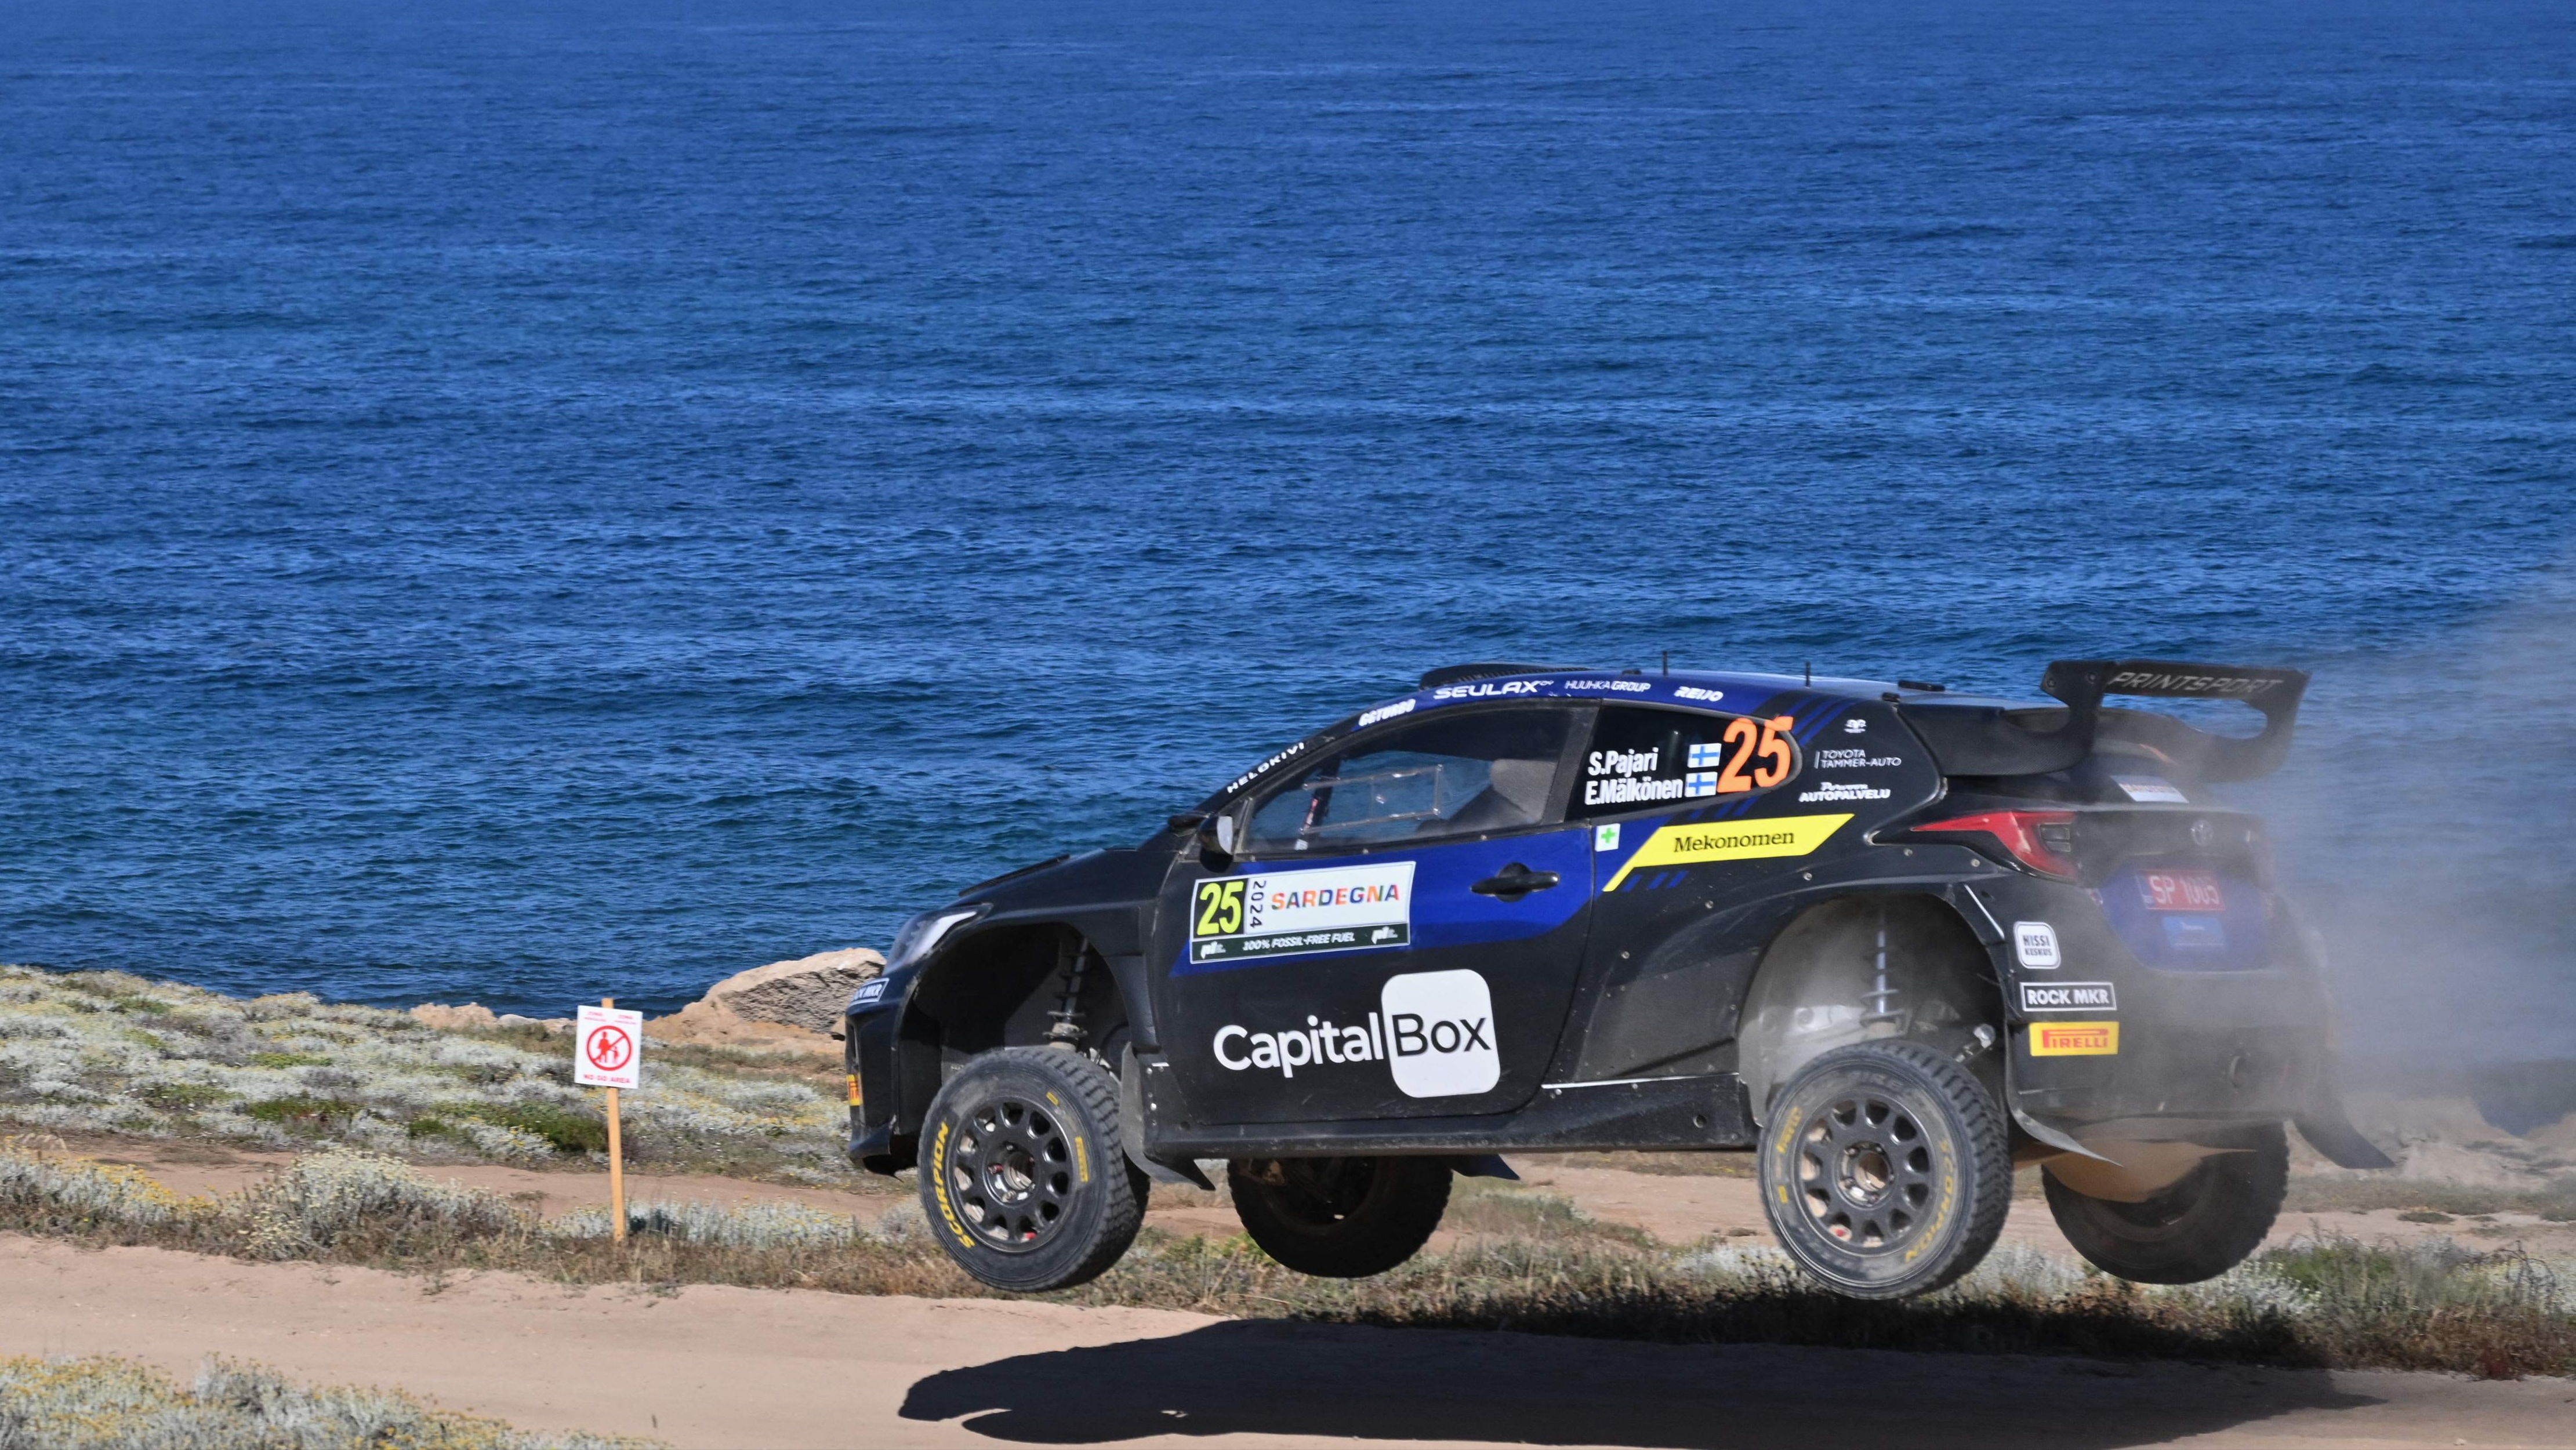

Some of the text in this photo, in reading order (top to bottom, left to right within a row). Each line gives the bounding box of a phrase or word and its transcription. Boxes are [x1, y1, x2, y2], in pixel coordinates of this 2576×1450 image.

[1434, 681, 1540, 699] SEULAX
[2108, 671, 2284, 693] PRINTSPORT
[1587, 747, 1659, 777] S.Pajari
[1717, 716, 1793, 793] 25
[1821, 757, 1902, 769] TAMMER-AUTO
[1822, 749, 1866, 759] TOYOTA
[1227, 742, 1304, 794] HELOKIVI
[1585, 776, 1683, 805] E.Mälkönen
[1799, 788, 1891, 802] AUTOPALVELU
[1674, 833, 1794, 852] Mekonomen
[1271, 884, 1399, 910] SARDEGNA
[2149, 875, 2176, 904] SP
[1197, 881, 1244, 935] 25
[1250, 881, 1267, 928] 2024
[1243, 940, 1270, 951] 100%
[1331, 932, 1355, 943] FUEL
[2023, 935, 2050, 947] HISSI
[2024, 948, 2052, 956] KESKUS
[2027, 989, 2109, 1005] ROCK MKR
[2042, 1029, 2109, 1049] PIRELLI
[933, 1118, 975, 1248] SCORPION
